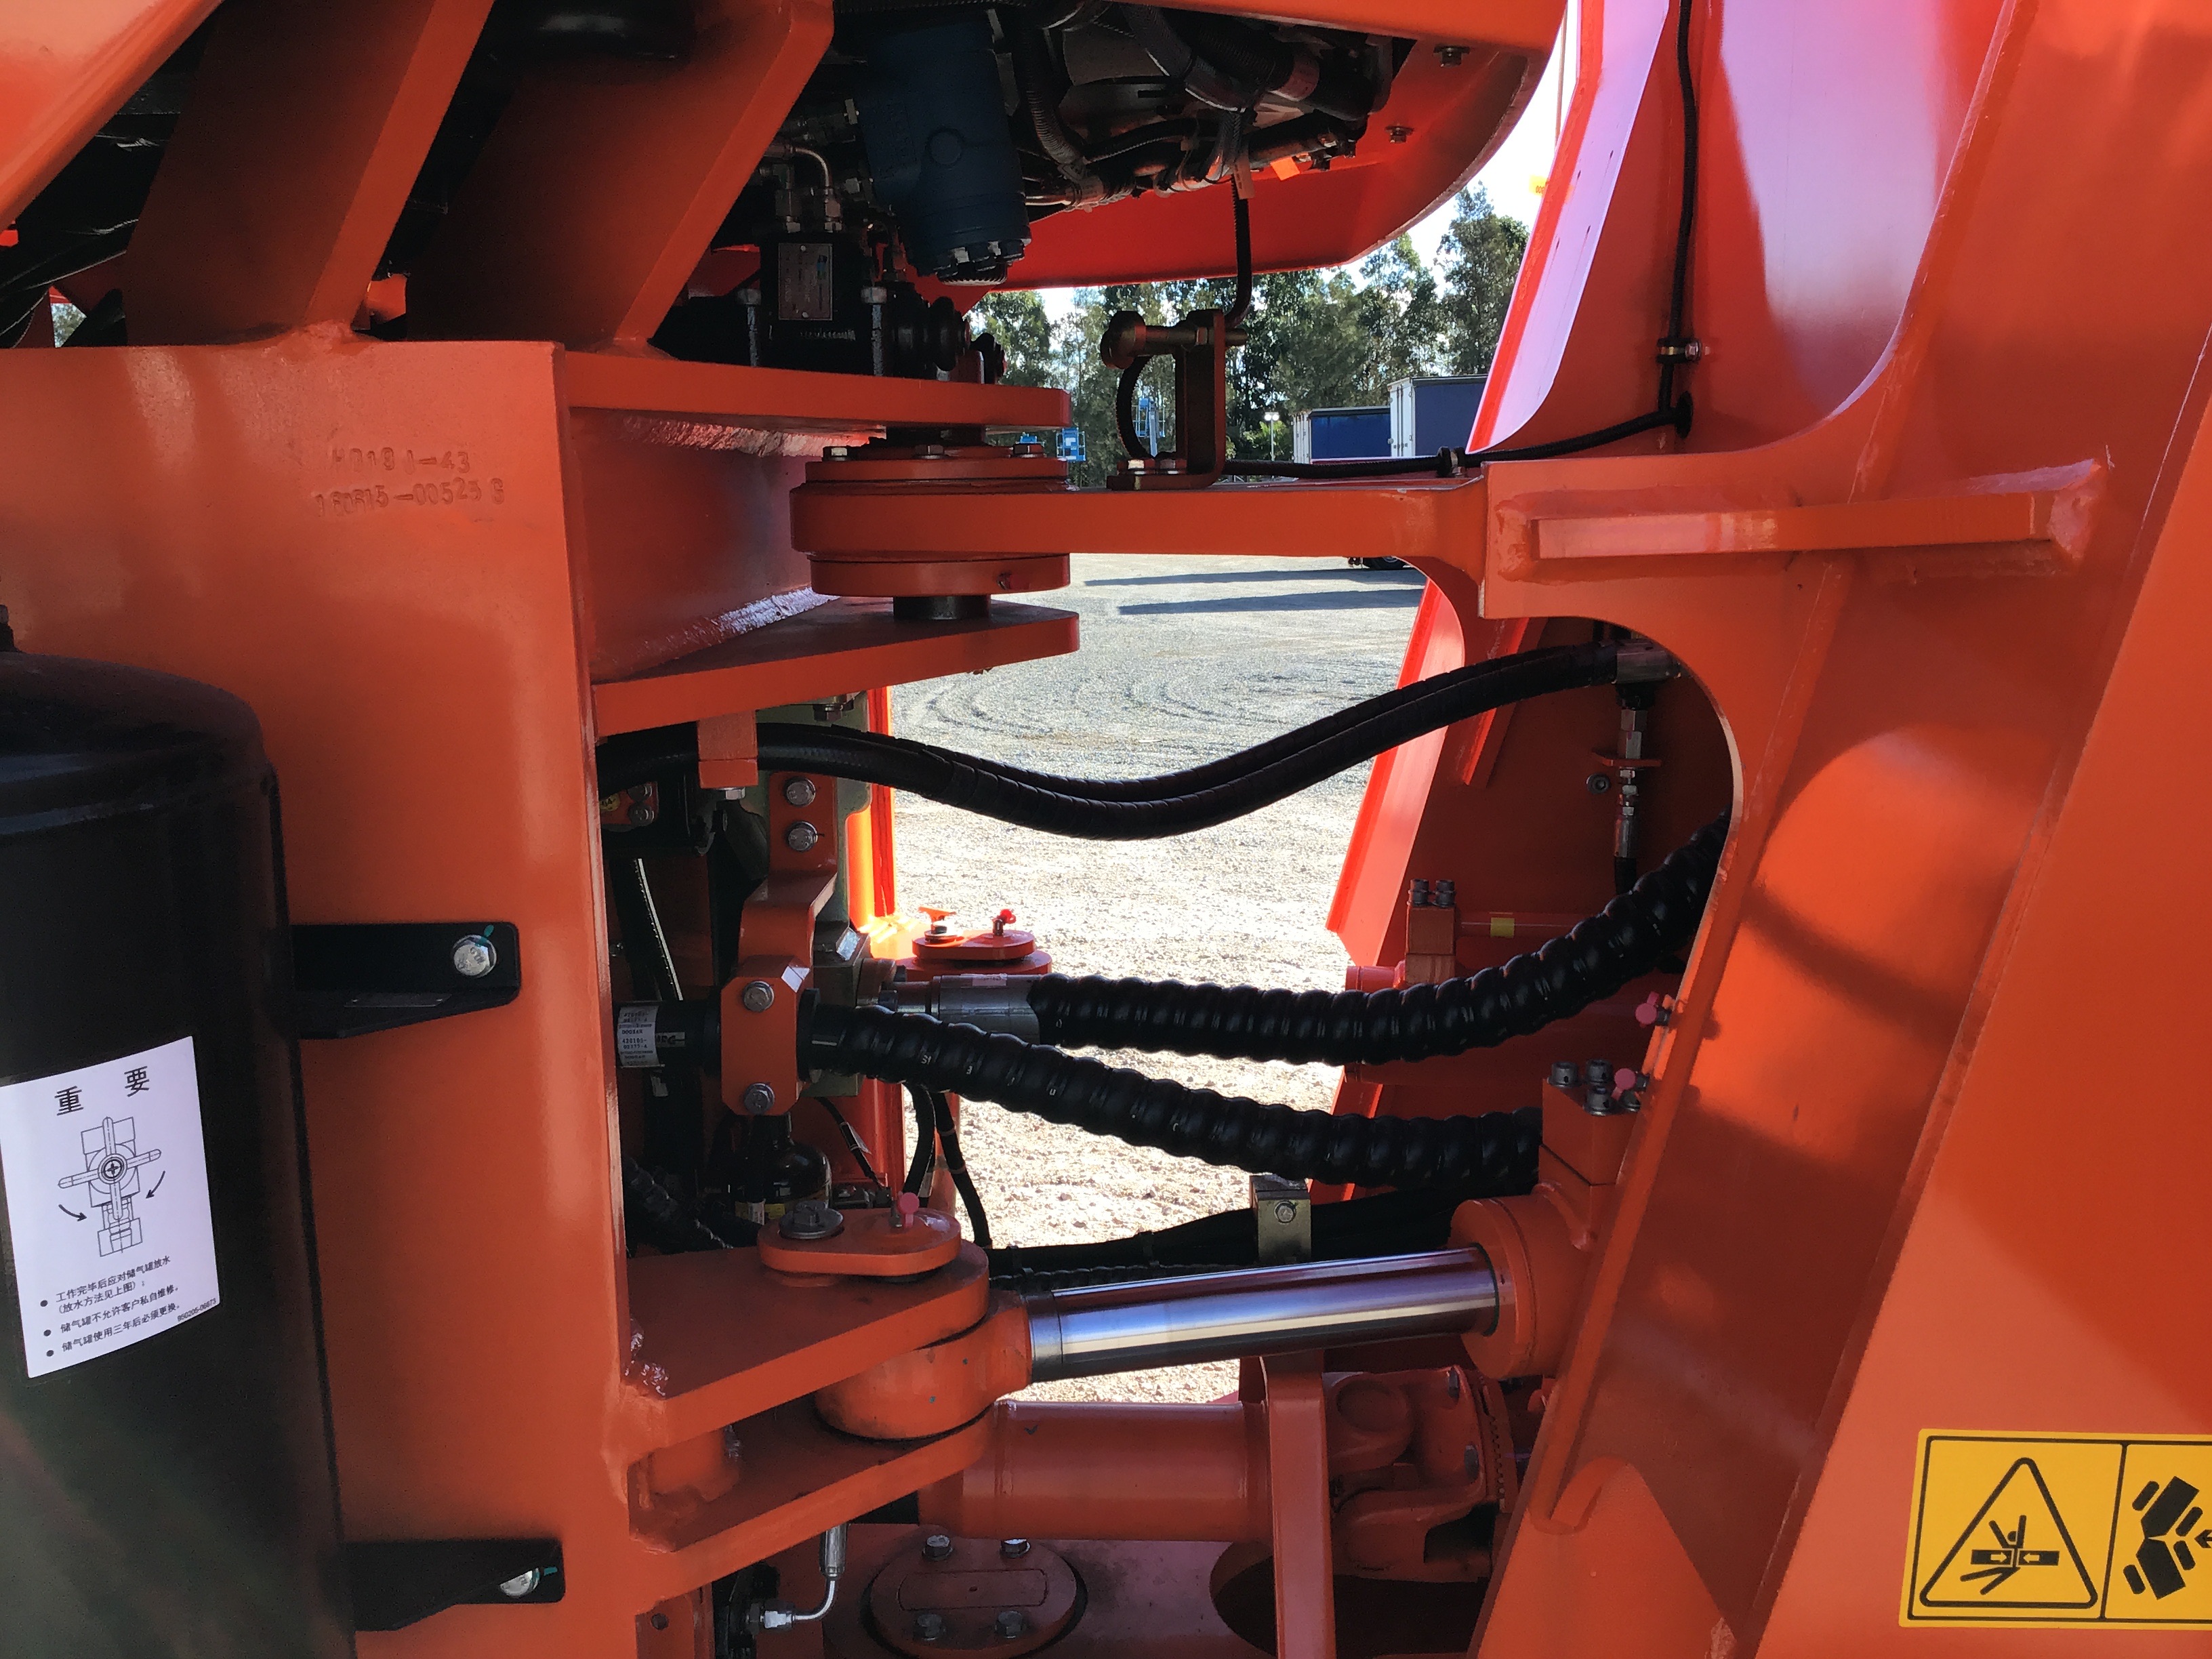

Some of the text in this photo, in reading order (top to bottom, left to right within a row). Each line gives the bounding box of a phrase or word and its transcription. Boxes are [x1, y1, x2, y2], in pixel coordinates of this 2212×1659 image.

[54, 1065, 150, 1115] 重 要
[56, 1255, 171, 1303] 工作完毕后应对储气罐放水
[60, 1284, 178, 1333] 储气罐不允许客户私自维修。
[62, 1303, 180, 1352] 储气罐使用三年后必须更换。
